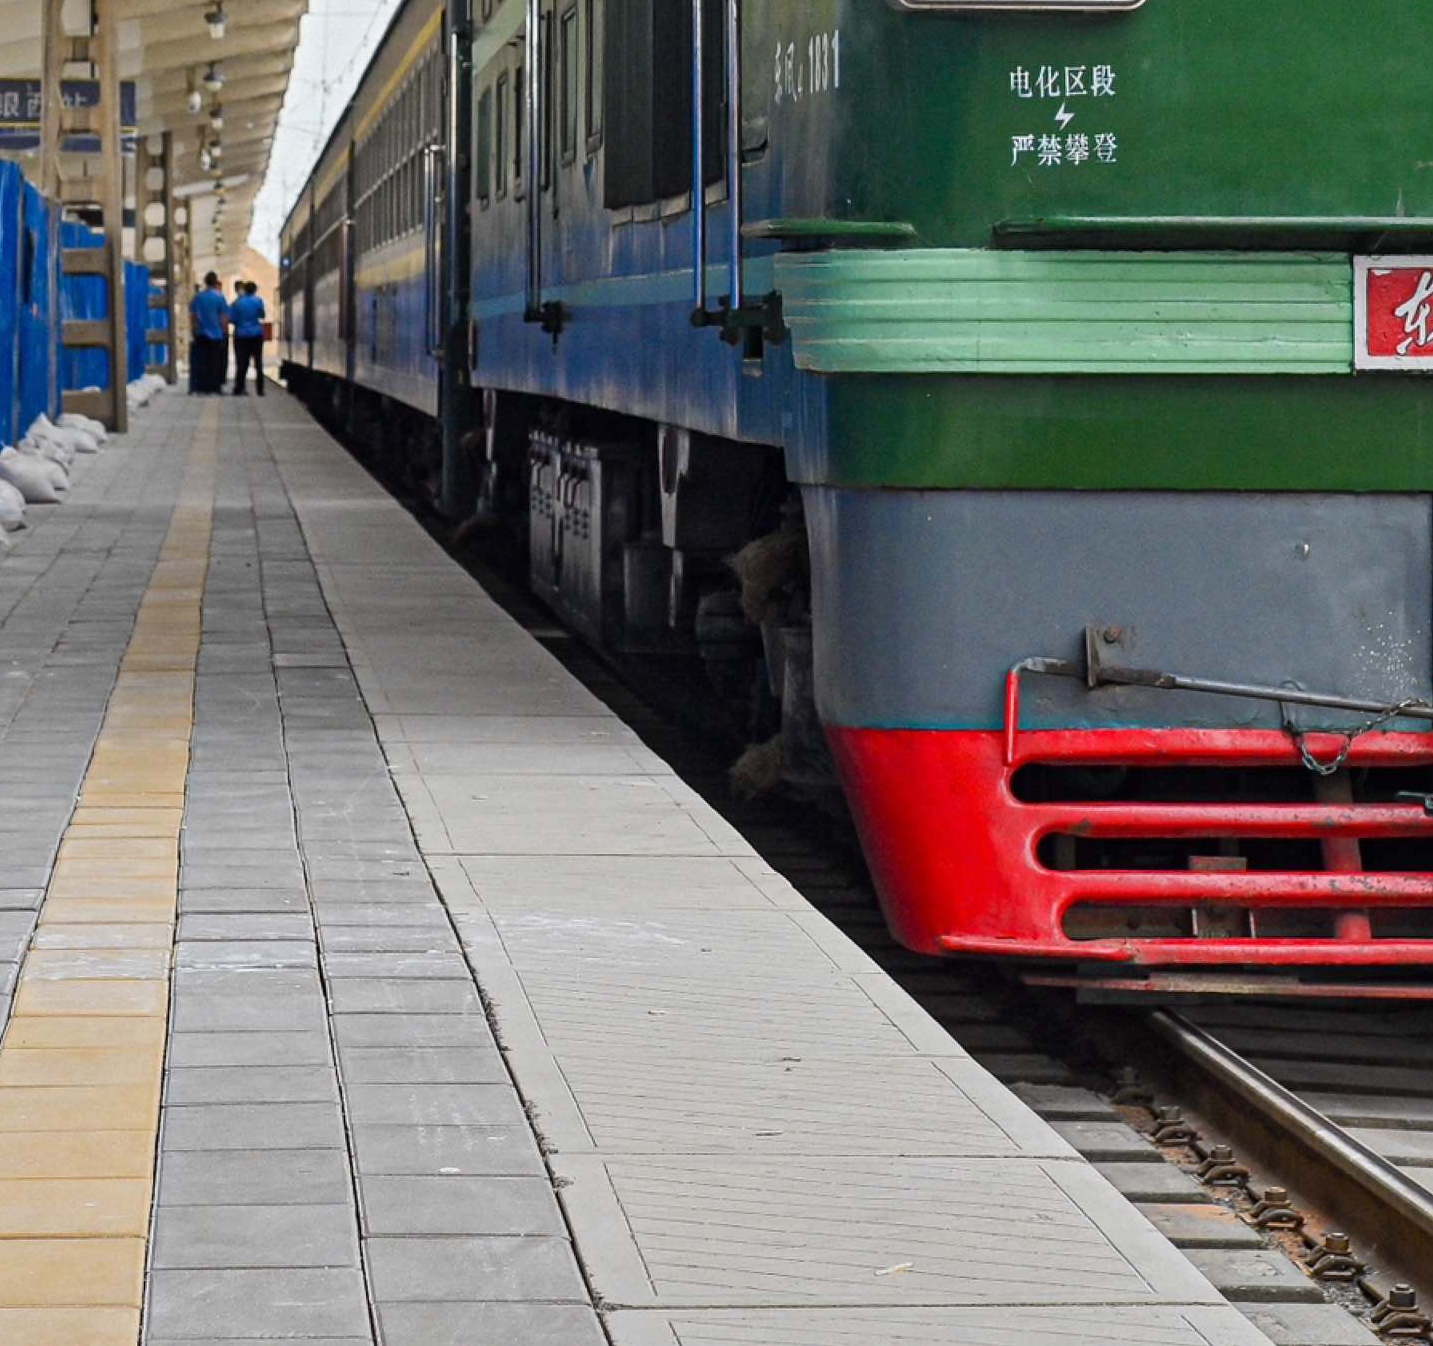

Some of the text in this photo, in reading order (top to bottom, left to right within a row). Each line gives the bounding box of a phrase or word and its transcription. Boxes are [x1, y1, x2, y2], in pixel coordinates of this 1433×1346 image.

[1009, 64, 1118, 98] 电化区段
[1010, 132, 1119, 167] 严禁攀登
